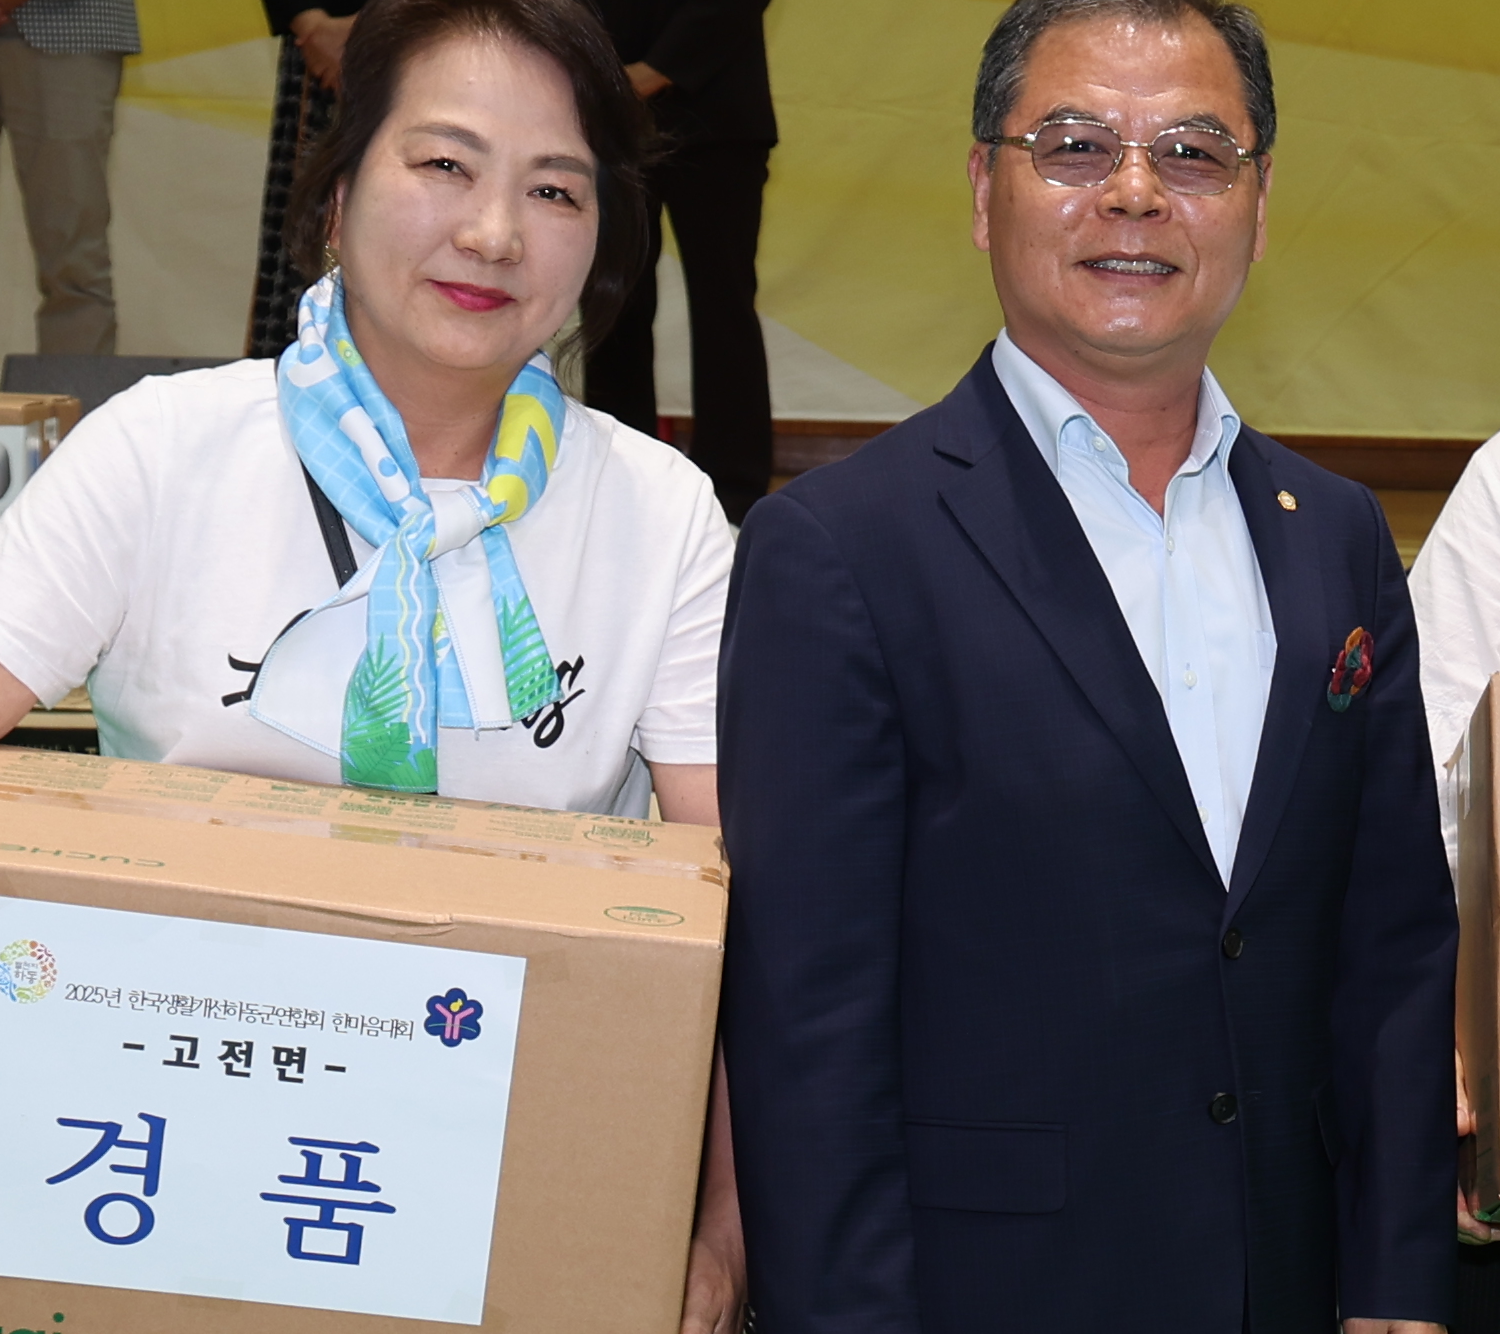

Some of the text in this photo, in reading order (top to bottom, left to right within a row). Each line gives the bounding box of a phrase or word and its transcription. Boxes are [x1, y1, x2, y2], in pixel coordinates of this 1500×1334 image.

[13, 969, 39, 986] 하동
[65, 982, 415, 1041] 2025년 한국생활개선하동군연합회 한마음대회
[162, 1033, 309, 1085] 고전면
[45, 1111, 398, 1267] 경 품
